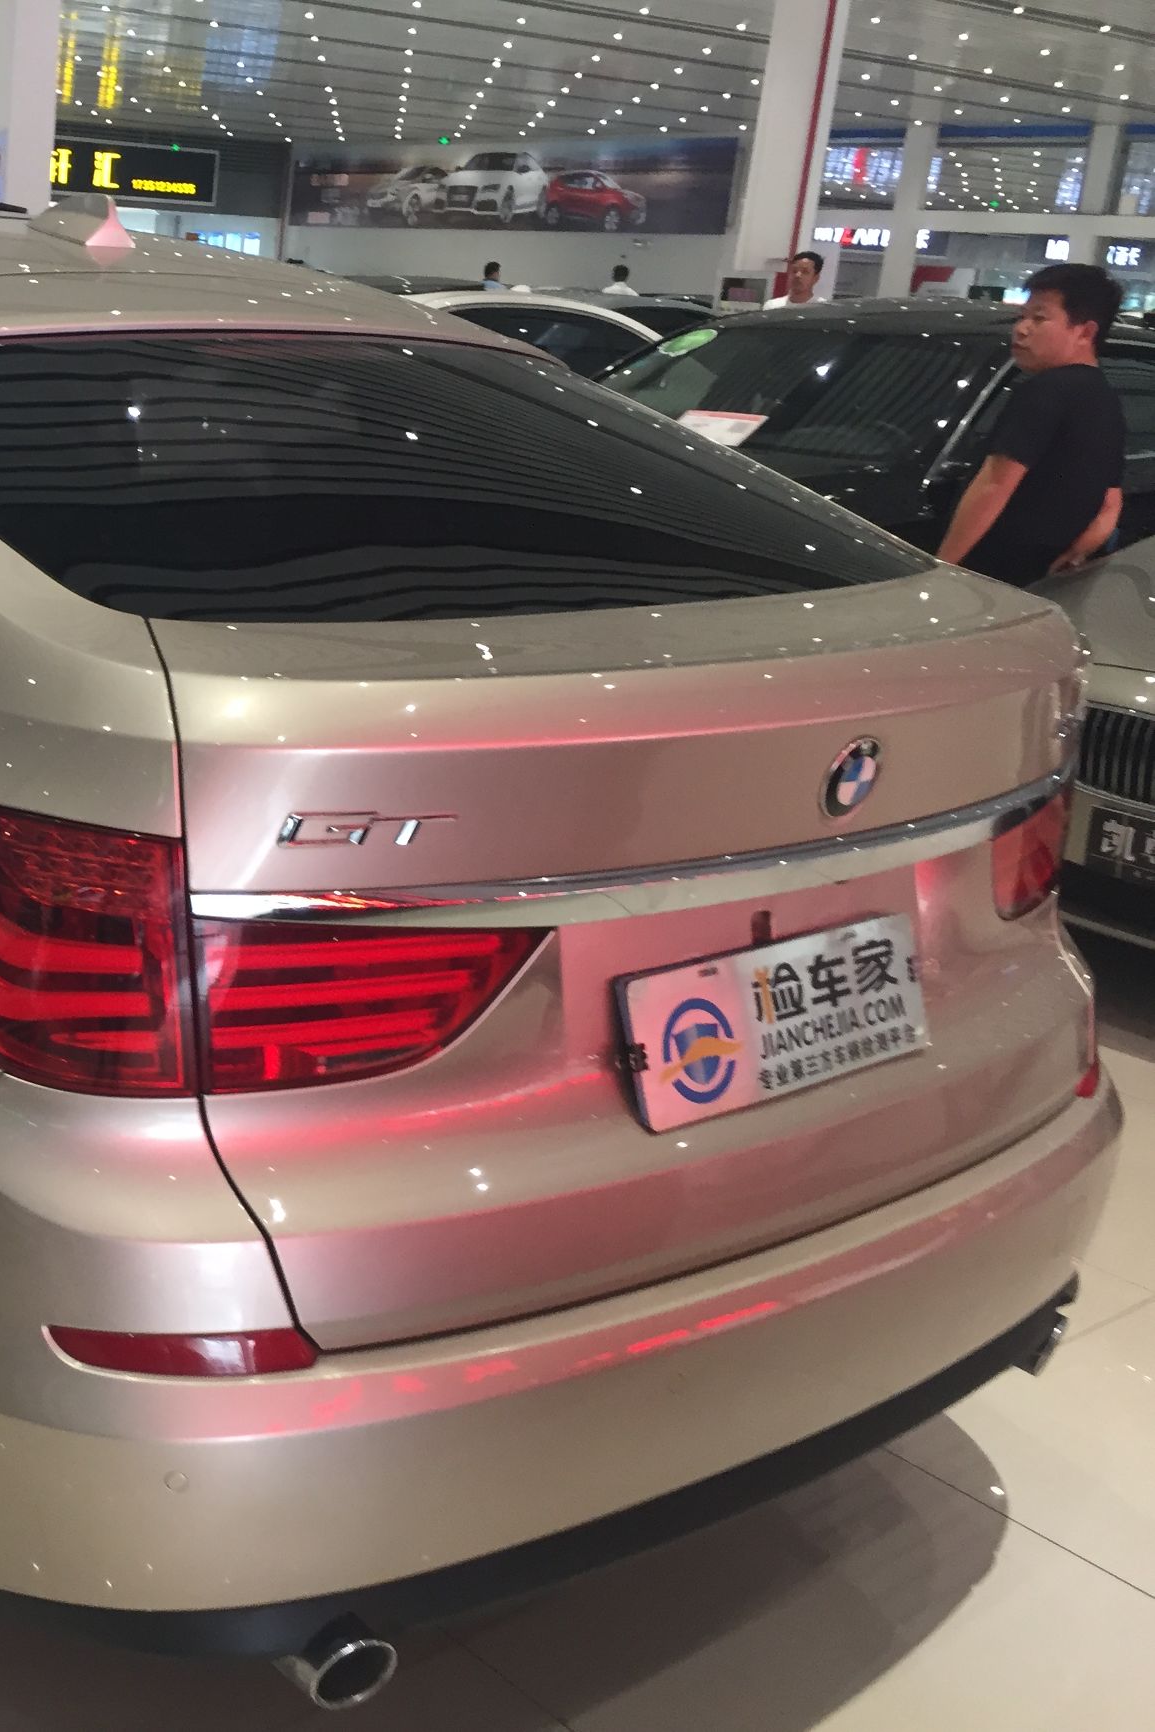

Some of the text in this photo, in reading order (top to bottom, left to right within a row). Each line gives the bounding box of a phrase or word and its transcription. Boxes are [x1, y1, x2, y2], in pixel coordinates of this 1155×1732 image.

[751, 937, 899, 1024] 检车家
[760, 993, 908, 1060] JIANCHEJIA.COM
